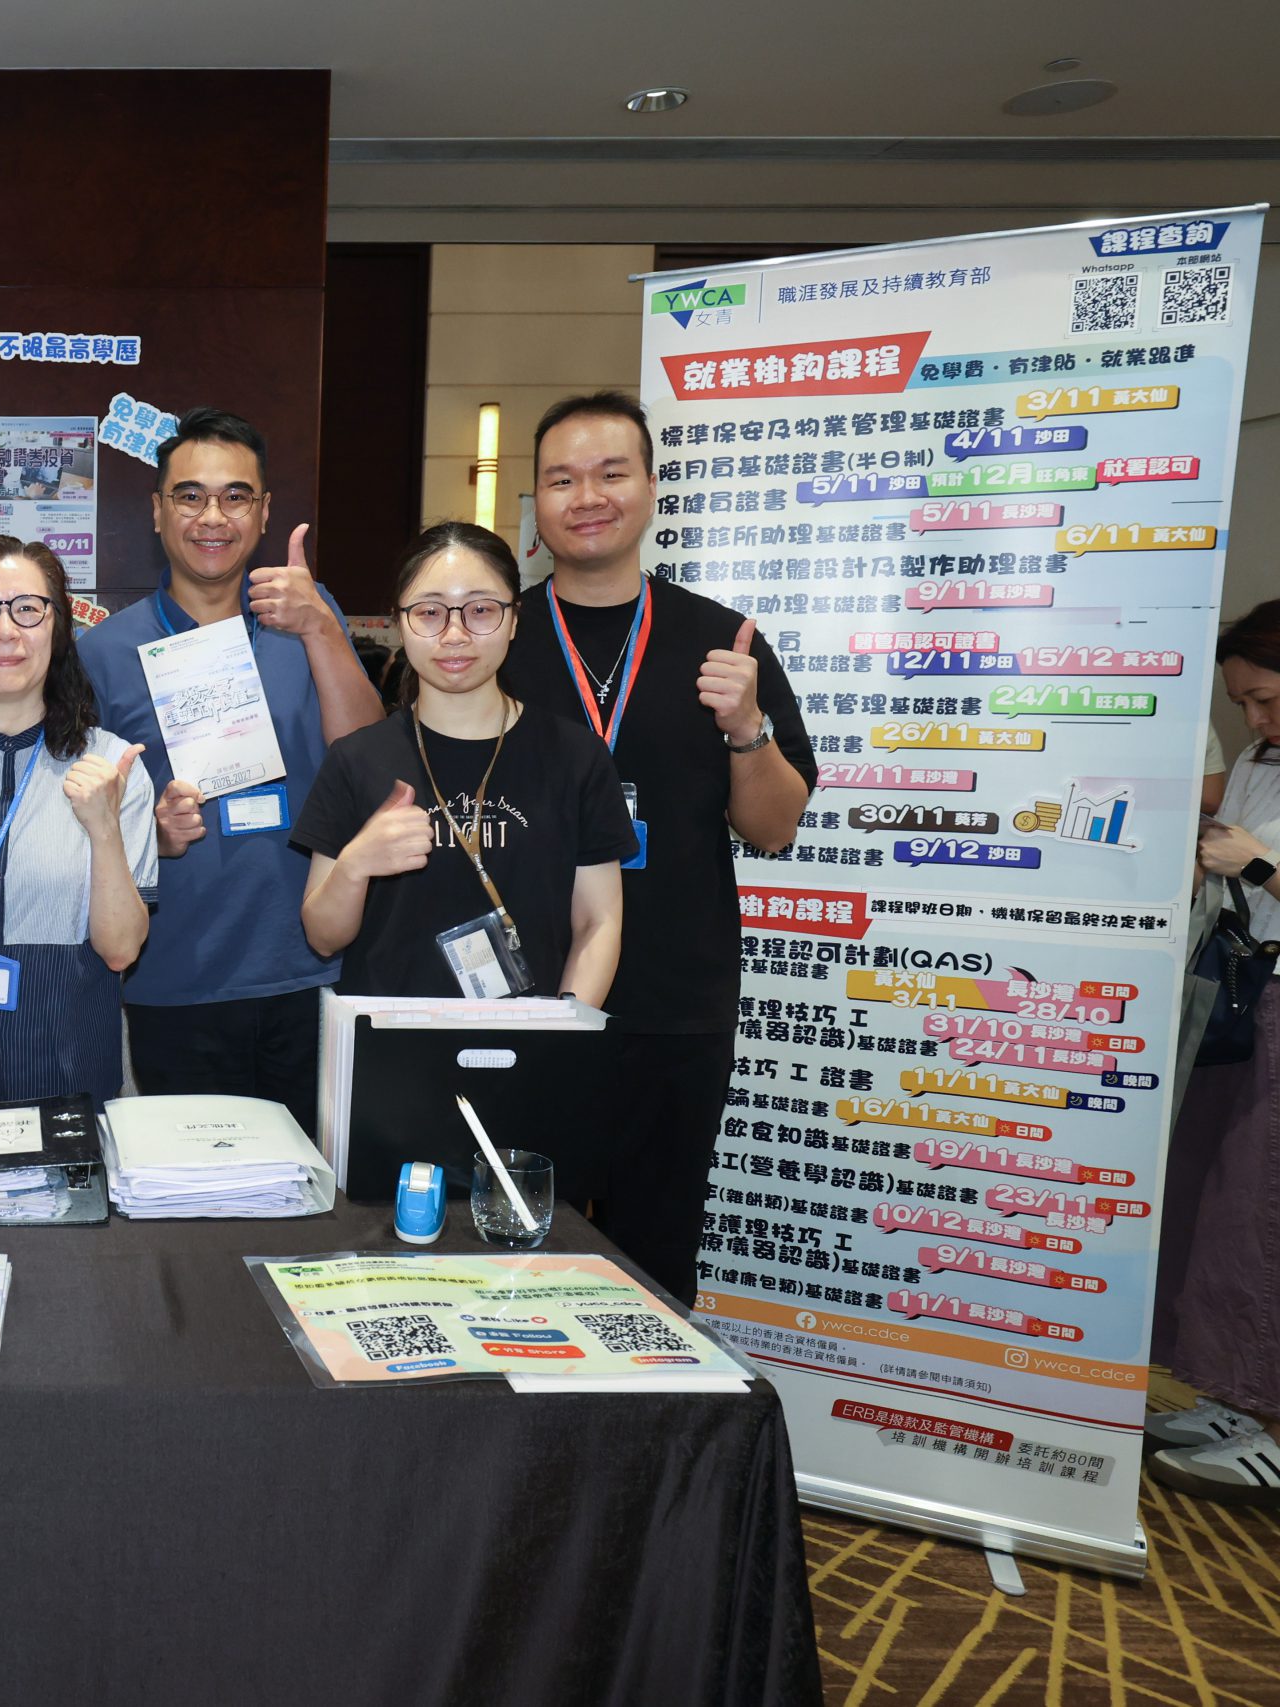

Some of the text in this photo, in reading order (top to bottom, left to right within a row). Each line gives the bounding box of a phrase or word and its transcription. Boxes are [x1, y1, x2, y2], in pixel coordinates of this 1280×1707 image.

[1101, 222, 1215, 254] 課程查詢
[1081, 262, 1135, 274] Whatsapp
[665, 289, 734, 310] YWCA
[777, 265, 992, 305] 職涯發展及持續教育部
[695, 308, 732, 328] 女青
[113, 396, 179, 440] 免學費
[659, 387, 1169, 448] 標準保安及物業管理基礎證書 3/11 黃大仙
[658, 427, 1070, 482] 陪月員基礎證書(半日制) 4/11 沙田
[657, 488, 788, 516] 保健員證書
[812, 473, 879, 496] 5/11
[888, 475, 922, 491] 沙田
[969, 462, 1034, 486] 12月
[1035, 467, 1089, 484] 旺角東
[1103, 456, 1192, 478] 社署認可
[655, 502, 1055, 550] 中醫診所助理基礎證書 5/11 長沙灣
[48, 537, 90, 551] 30/11
[654, 523, 1208, 583] 創意數碼媒體設計及製作助理證書 6/11 黃大仙
[919, 581, 988, 601] 9/11
[989, 584, 1041, 600] 長沙灣
[853, 632, 996, 651] 醫管局認可證書
[889, 650, 972, 671] 12/11
[978, 654, 1014, 670] 沙田
[1021, 647, 1113, 668] 15/12
[1122, 651, 1180, 668] 黃大仙
[796, 685, 1149, 717] 業管理基礎證書 24/11 旺角東
[883, 722, 969, 743] 26/11
[977, 730, 1031, 746] 黃大仙
[819, 764, 959, 785] 27/11 長沙灣
[497, 796, 529, 828] Dream
[858, 804, 945, 825] 30/11
[954, 812, 988, 827] 葵芳
[910, 838, 1022, 862] 9/12 沙田
[741, 936, 993, 976] 課程認可計劃(QAS)
[874, 969, 937, 989] 黃大仙
[1006, 979, 1075, 1002] 長沙灣
[1101, 985, 1131, 998] 日間
[892, 989, 1111, 1025] 3/11 28/10
[929, 1014, 1024, 1041] 31/10
[1030, 1024, 1082, 1043] 長沙灣
[1108, 1038, 1138, 1051] 日間
[955, 1037, 1153, 1088] 24/11 長沙灣 晚間
[913, 1067, 998, 1093] 11/11
[1004, 1080, 1060, 1100] 黃大仙
[1087, 1097, 1118, 1111] 晚間
[849, 1097, 930, 1123] 16/11
[936, 1110, 989, 1128] 黃大仙
[1016, 1125, 1044, 1138] 日間
[717, 1116, 1128, 1185] 飲食知識基礎證書 19/11 長沙灣 日間
[994, 1184, 1144, 1215] 23/11 日間
[878, 1203, 962, 1231] 10/12
[966, 1219, 1022, 1241] 長沙灣
[1046, 1238, 1074, 1252] 日間
[1046, 1212, 1107, 1234] 長沙灣
[937, 1244, 987, 1269] 9/1
[990, 1256, 1046, 1280] 長沙灣
[1070, 1277, 1099, 1291] 日間
[898, 1289, 961, 1315] 11/1
[969, 1304, 1024, 1327] 長沙灣
[1047, 1325, 1076, 1340] 日間
[396, 1360, 448, 1371] Facebook
[637, 1356, 694, 1364] Instagram
[821, 1317, 911, 1343] ywca.cdce
[1033, 1356, 1137, 1382] ywca_cdce
[879, 1363, 993, 1394] (詳情請參閱申請須知)
[1017, 1442, 1104, 1470] 委託約80間
